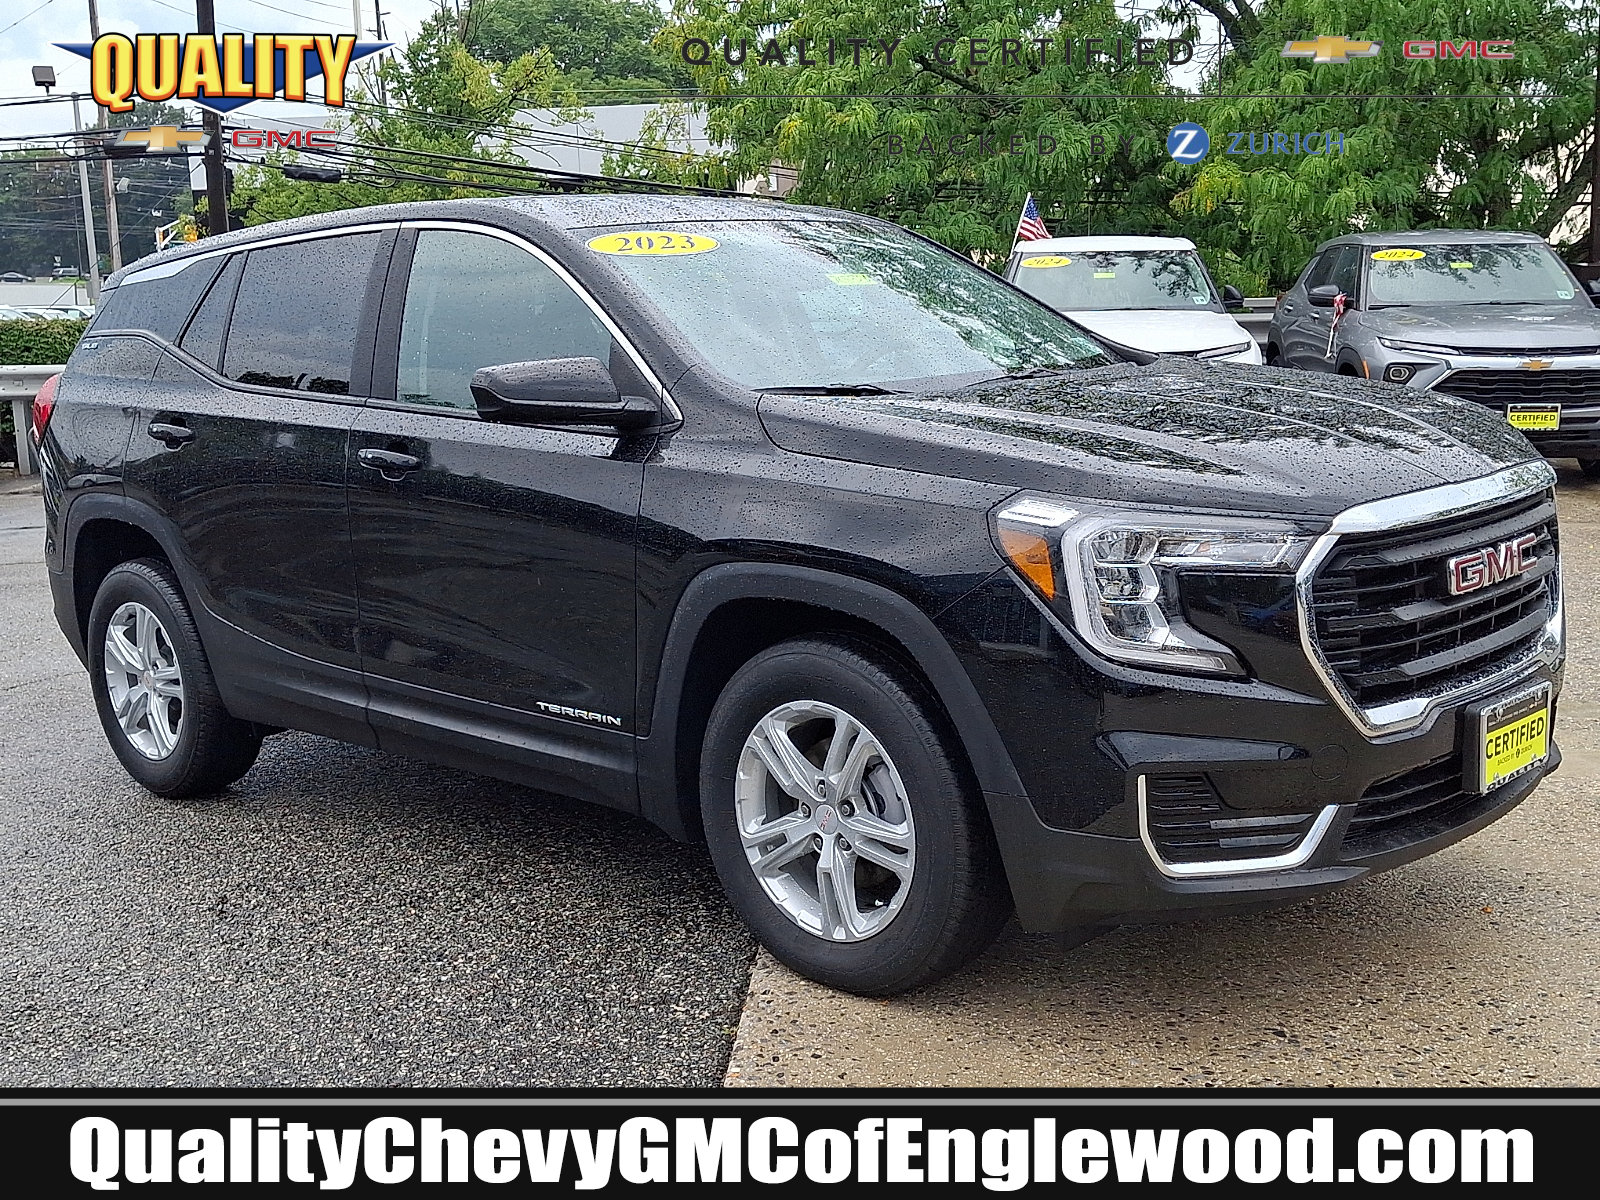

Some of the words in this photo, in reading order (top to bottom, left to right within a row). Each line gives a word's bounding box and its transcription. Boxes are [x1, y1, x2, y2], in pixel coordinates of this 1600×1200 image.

[614, 235, 696, 252] 2023
[1510, 414, 1556, 422] CERTIFIED
[1450, 533, 1538, 596] GMC
[536, 701, 622, 726] TERRAIN
[1485, 716, 1544, 760] CERTIFIED
[1486, 758, 1547, 792] QUALITY
